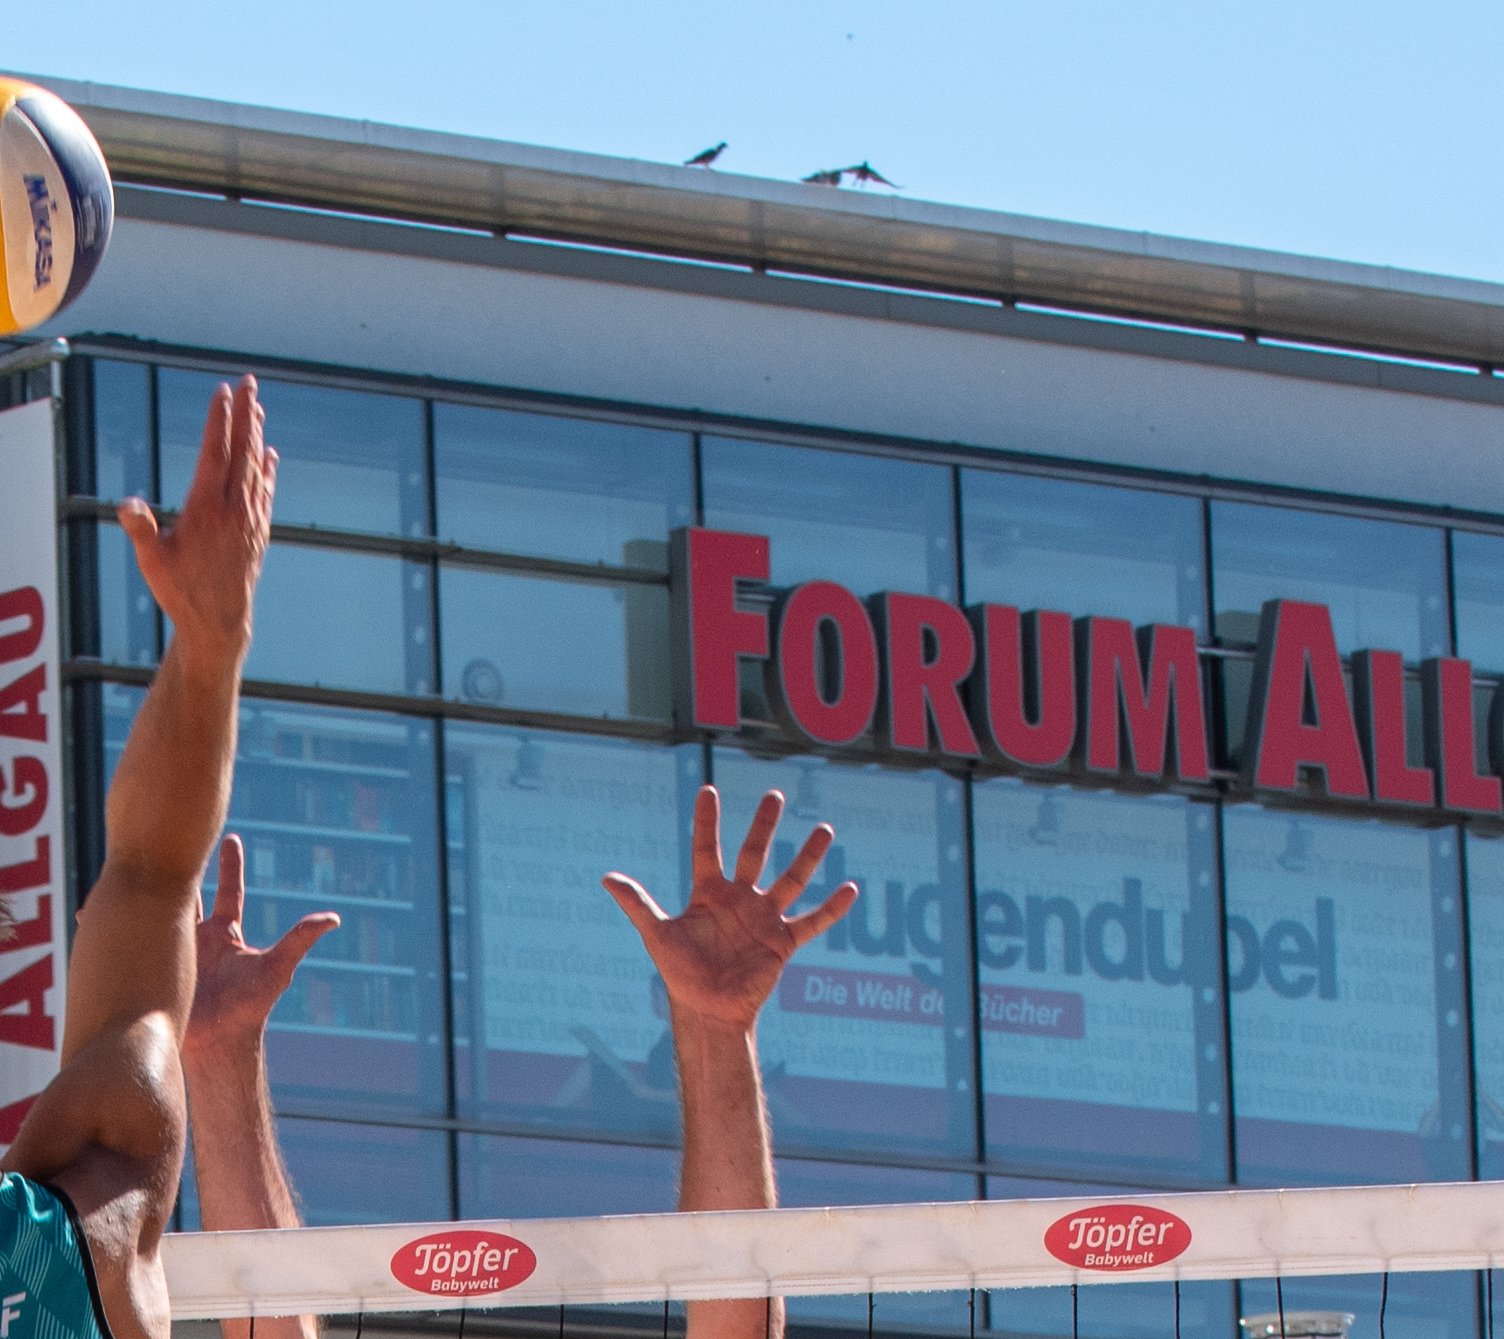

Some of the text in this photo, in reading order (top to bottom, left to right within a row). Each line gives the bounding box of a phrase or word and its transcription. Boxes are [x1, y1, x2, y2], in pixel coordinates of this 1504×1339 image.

[671, 525, 1210, 784] FORUM
[804, 974, 849, 1007] Die
[855, 980, 913, 1014] Welt
[1068, 1215, 1173, 1253] Töpfer
[415, 1241, 518, 1278] Töpfer
[1084, 1252, 1154, 1267] Babywelt
[431, 1277, 499, 1292] Babywelt
